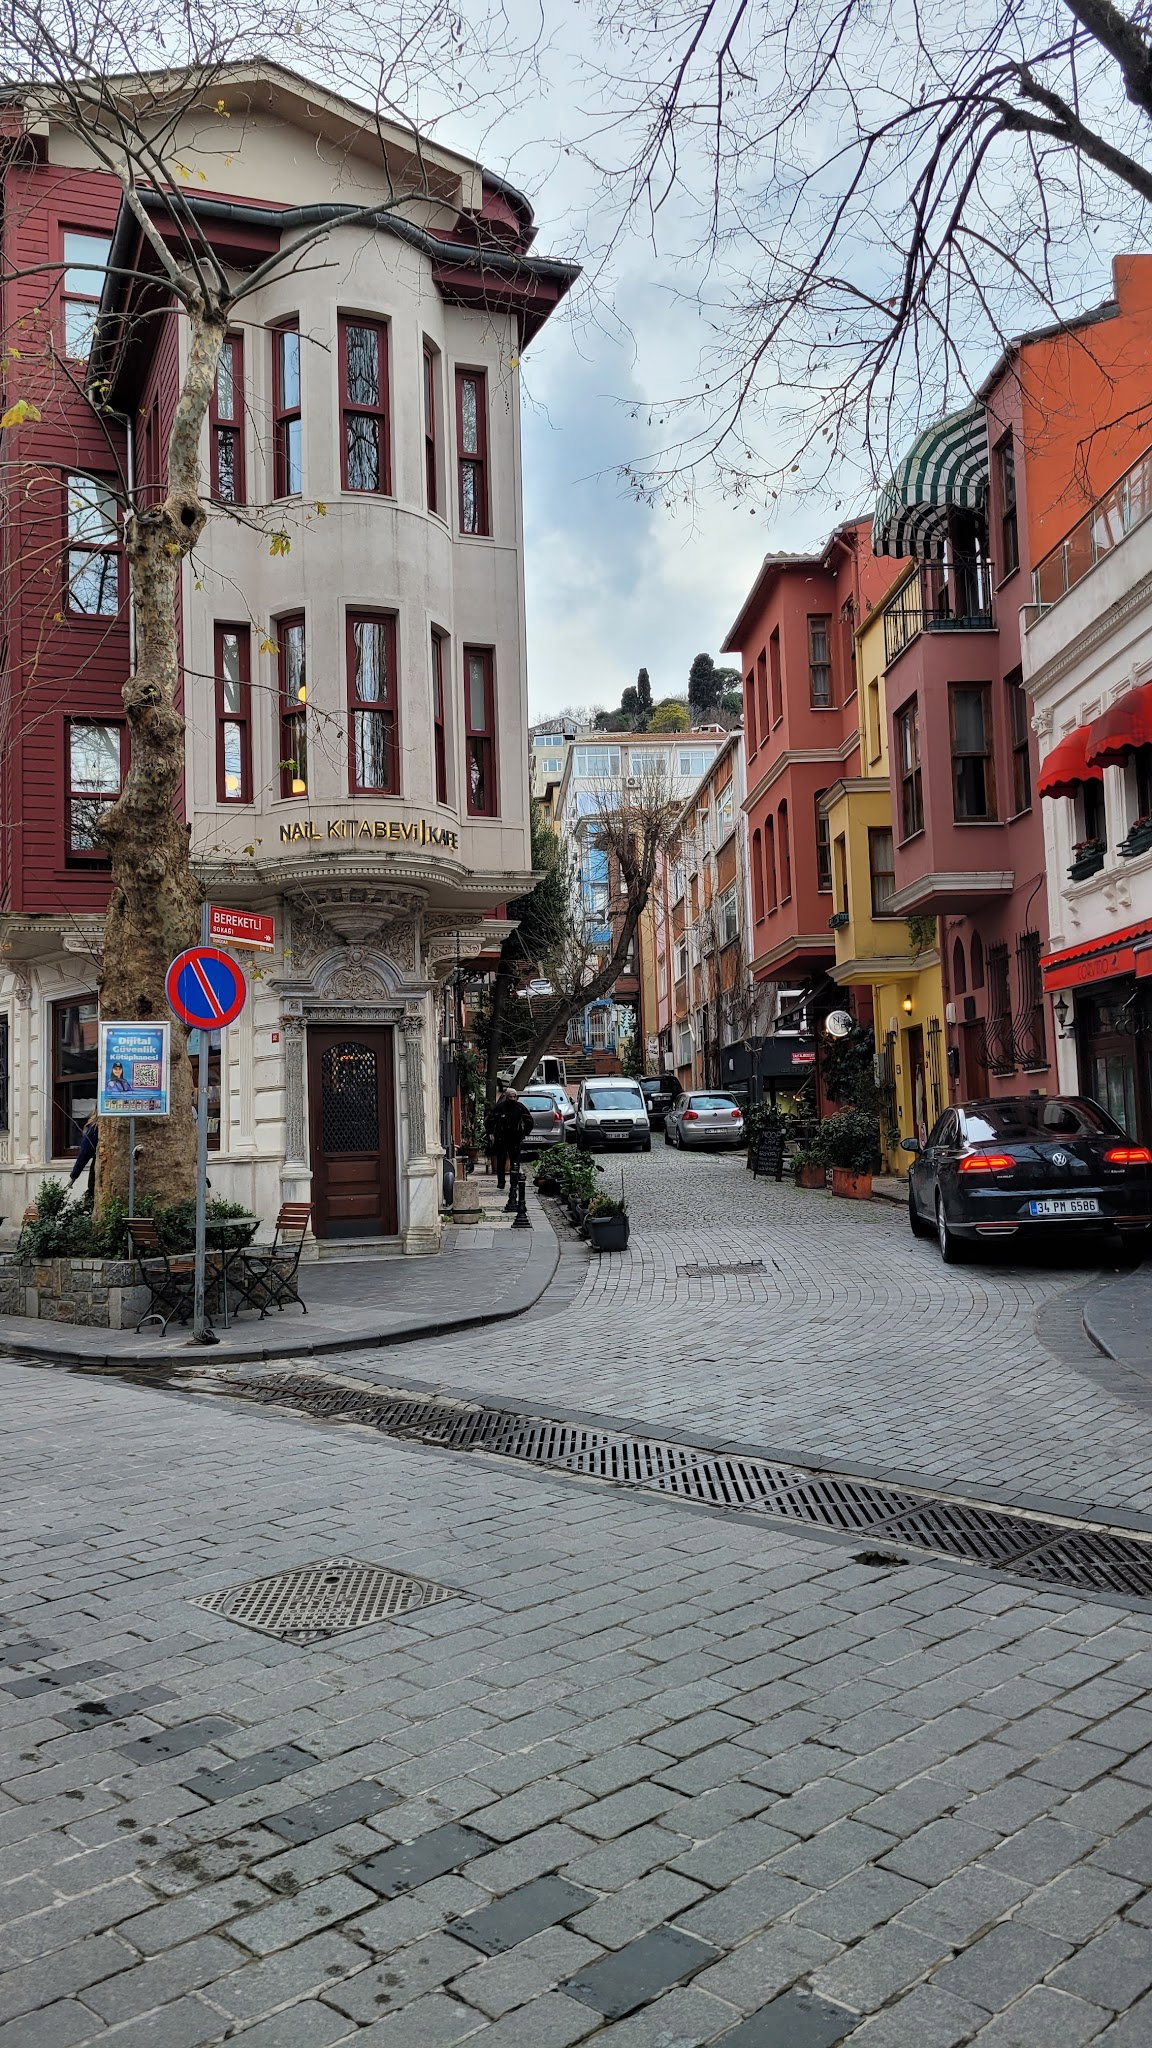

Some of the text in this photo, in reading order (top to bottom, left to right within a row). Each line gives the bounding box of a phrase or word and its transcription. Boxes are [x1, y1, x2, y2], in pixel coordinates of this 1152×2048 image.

[279, 821, 322, 842] NAİL
[427, 825, 459, 850] KAFE
[213, 912, 262, 931] BEREKETLİ
[118, 1036, 152, 1047] Dijital
[112, 1045, 157, 1054] Güvenlik
[109, 1053, 159, 1061] Kütüphanesi
[1037, 1202, 1050, 1213] 34
[1054, 1202, 1066, 1213] PM
[1070, 1200, 1096, 1212] 6586
